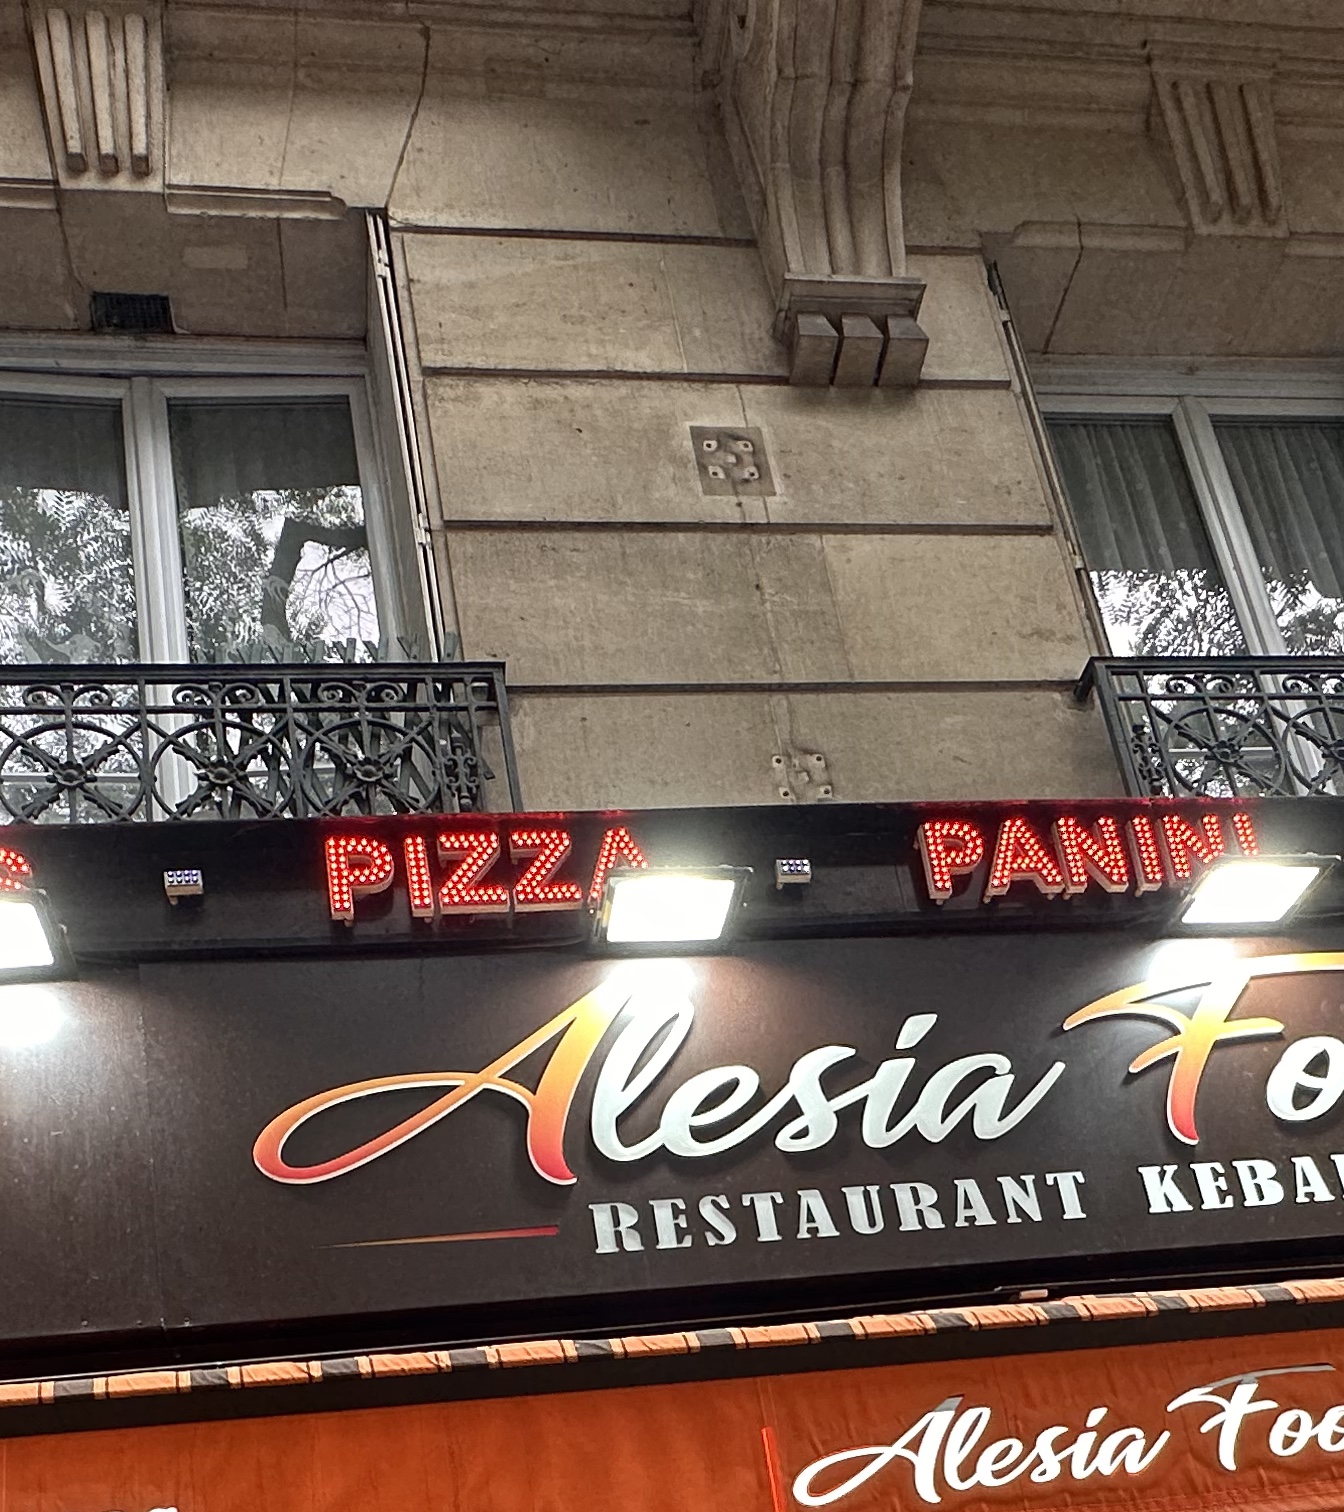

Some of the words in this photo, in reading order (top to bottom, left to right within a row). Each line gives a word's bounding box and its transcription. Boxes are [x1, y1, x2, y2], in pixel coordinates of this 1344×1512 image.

[253, 965, 1065, 1186] Alesia
[588, 1171, 1087, 1255] RESTAURANT
[791, 1395, 1169, 1509] Alesia
